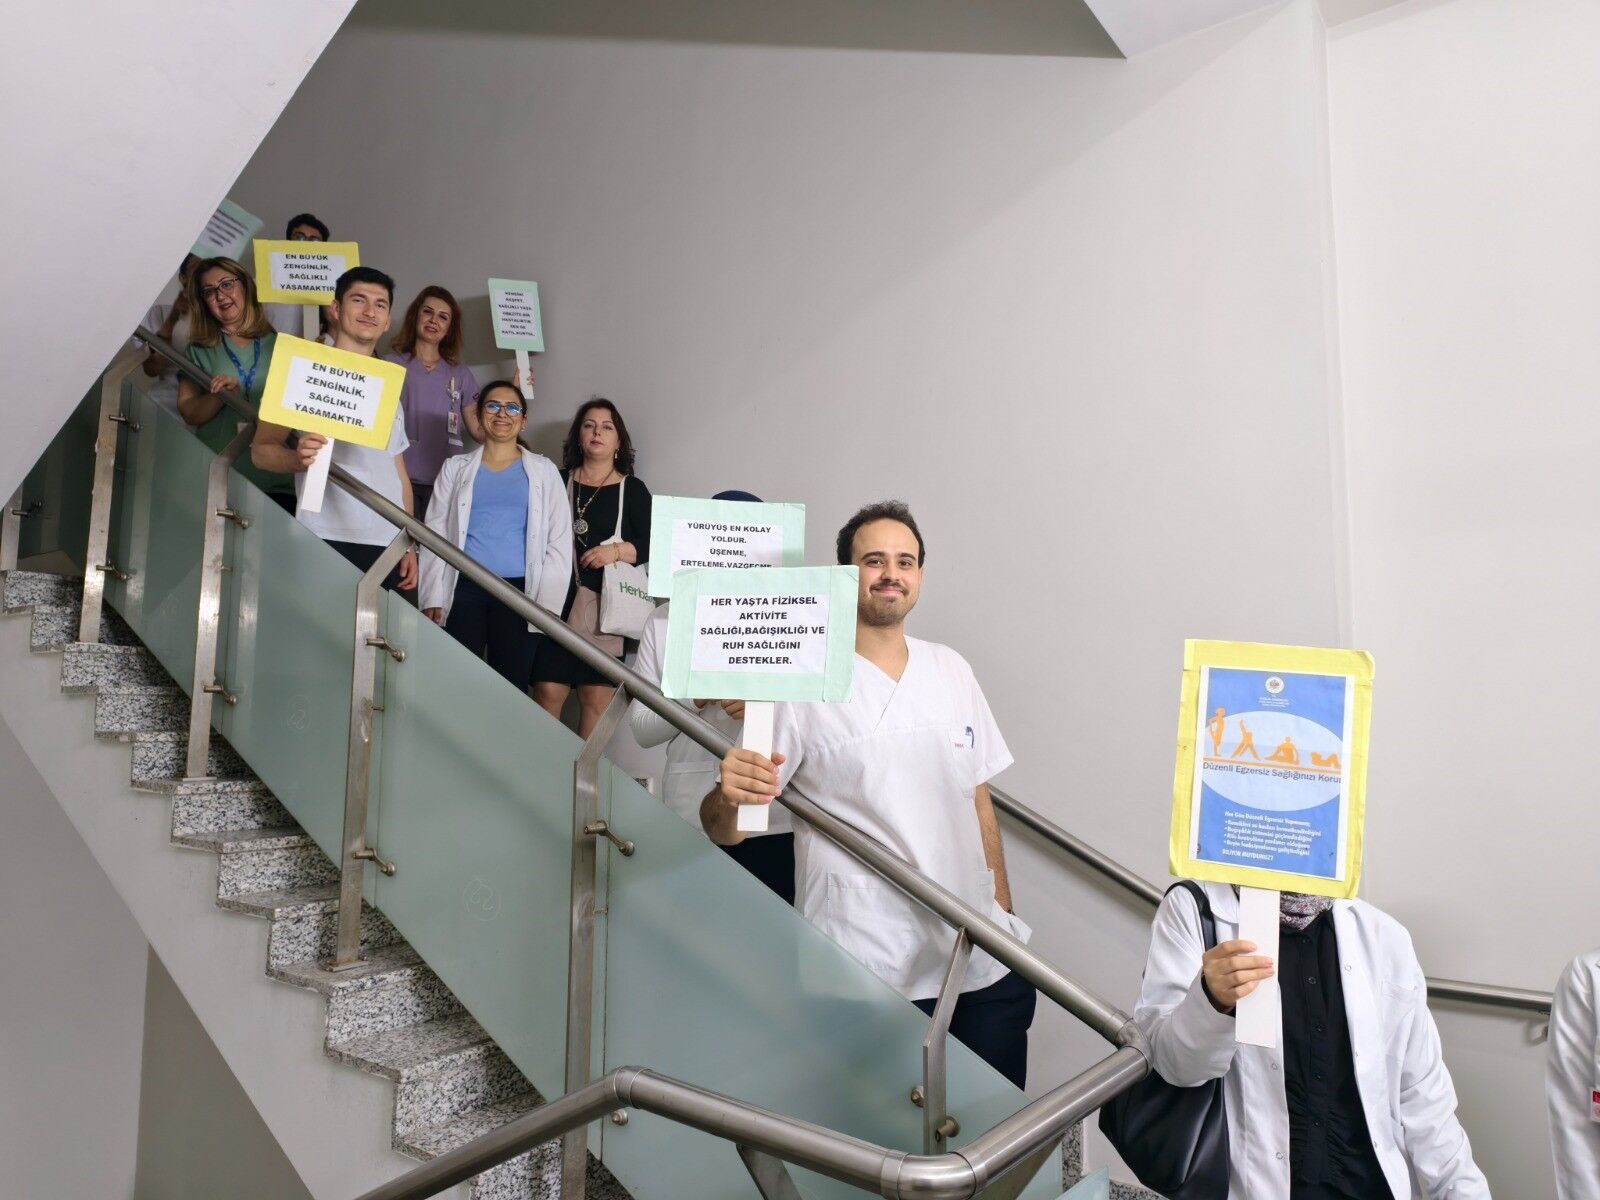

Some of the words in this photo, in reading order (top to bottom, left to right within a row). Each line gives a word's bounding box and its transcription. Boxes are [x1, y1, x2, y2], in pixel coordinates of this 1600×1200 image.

[284, 263, 332, 271] ZENGİNLİK,
[289, 272, 328, 280] SAĞLIKLI
[312, 362, 326, 372] EN
[330, 368, 366, 383] BÜYÜK
[306, 376, 365, 399] ZENGİNLİK,
[309, 392, 357, 410] SAĞLIKLI
[688, 522, 728, 532] YÜRÜYÜŞ
[710, 548, 747, 557] ÜŞENME,
[711, 598, 732, 606] HER
[735, 598, 769, 607] YAŞTA
[772, 596, 818, 605] FİZİKSEL
[740, 611, 787, 620] AKTİVİTE
[700, 625, 808, 636] SAĞLIĞI,BAĞIŞIKLIĞI
[811, 626, 825, 634] VE
[747, 640, 800, 649] SAĞLIĞINI
[1203, 762, 1233, 772] Düzenli
[1236, 765, 1270, 776] Egzersiz
[1272, 769, 1316, 780] Sağlığınızı
